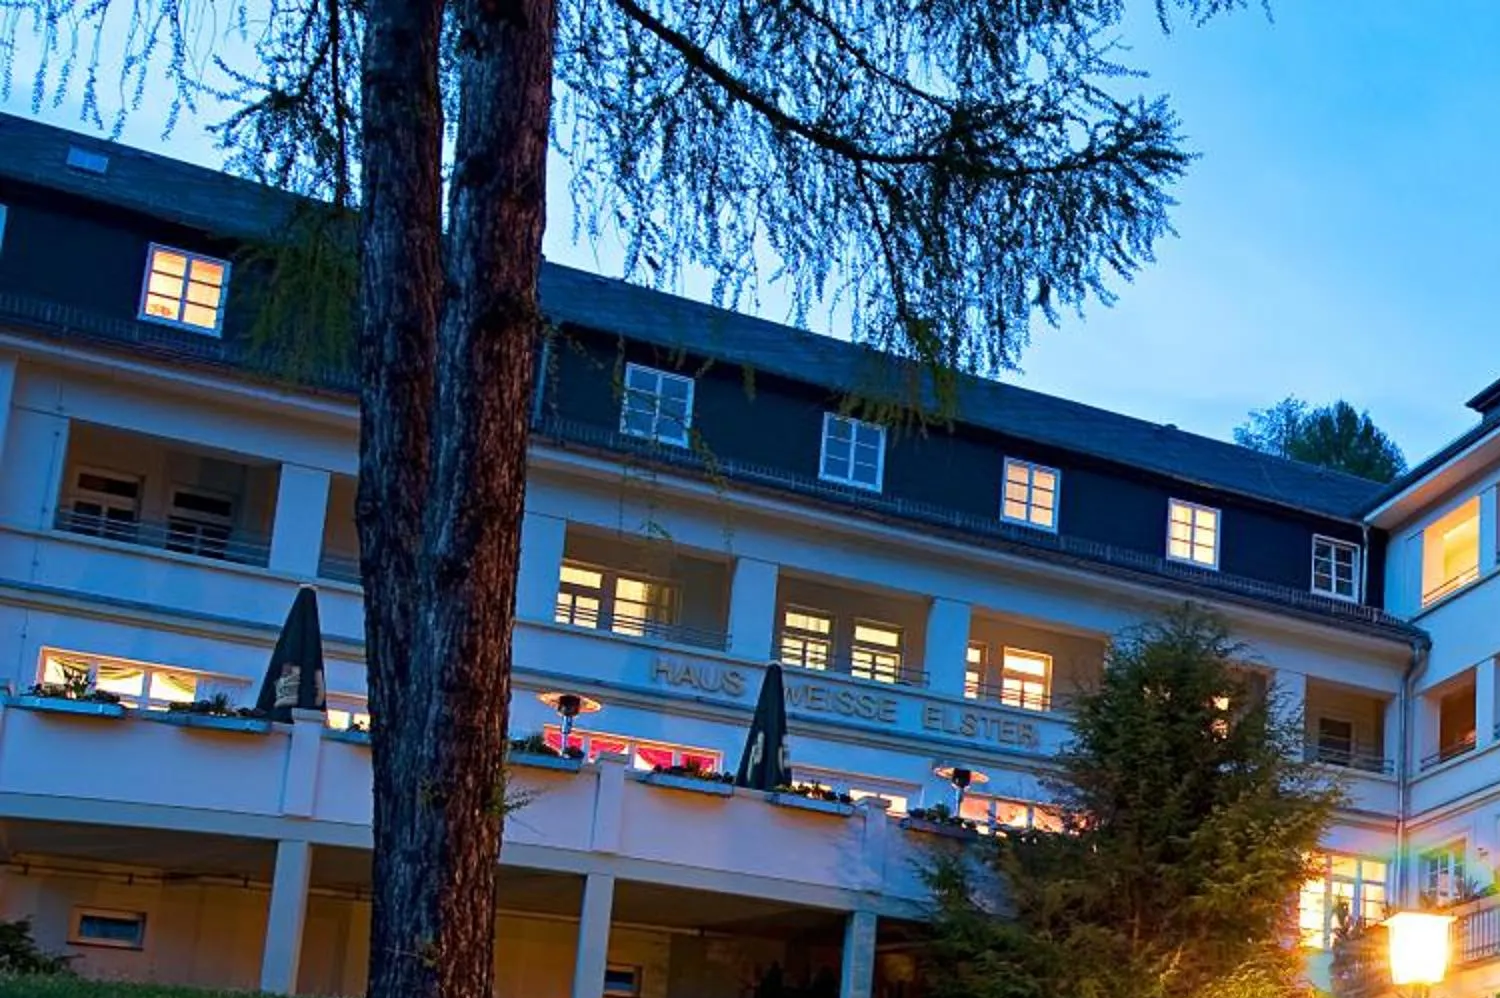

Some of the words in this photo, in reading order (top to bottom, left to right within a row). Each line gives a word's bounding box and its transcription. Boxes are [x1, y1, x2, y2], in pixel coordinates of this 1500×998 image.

[650, 657, 746, 697] HAUS
[783, 685, 897, 724] WEISSE
[923, 704, 1040, 748] ELSTER
